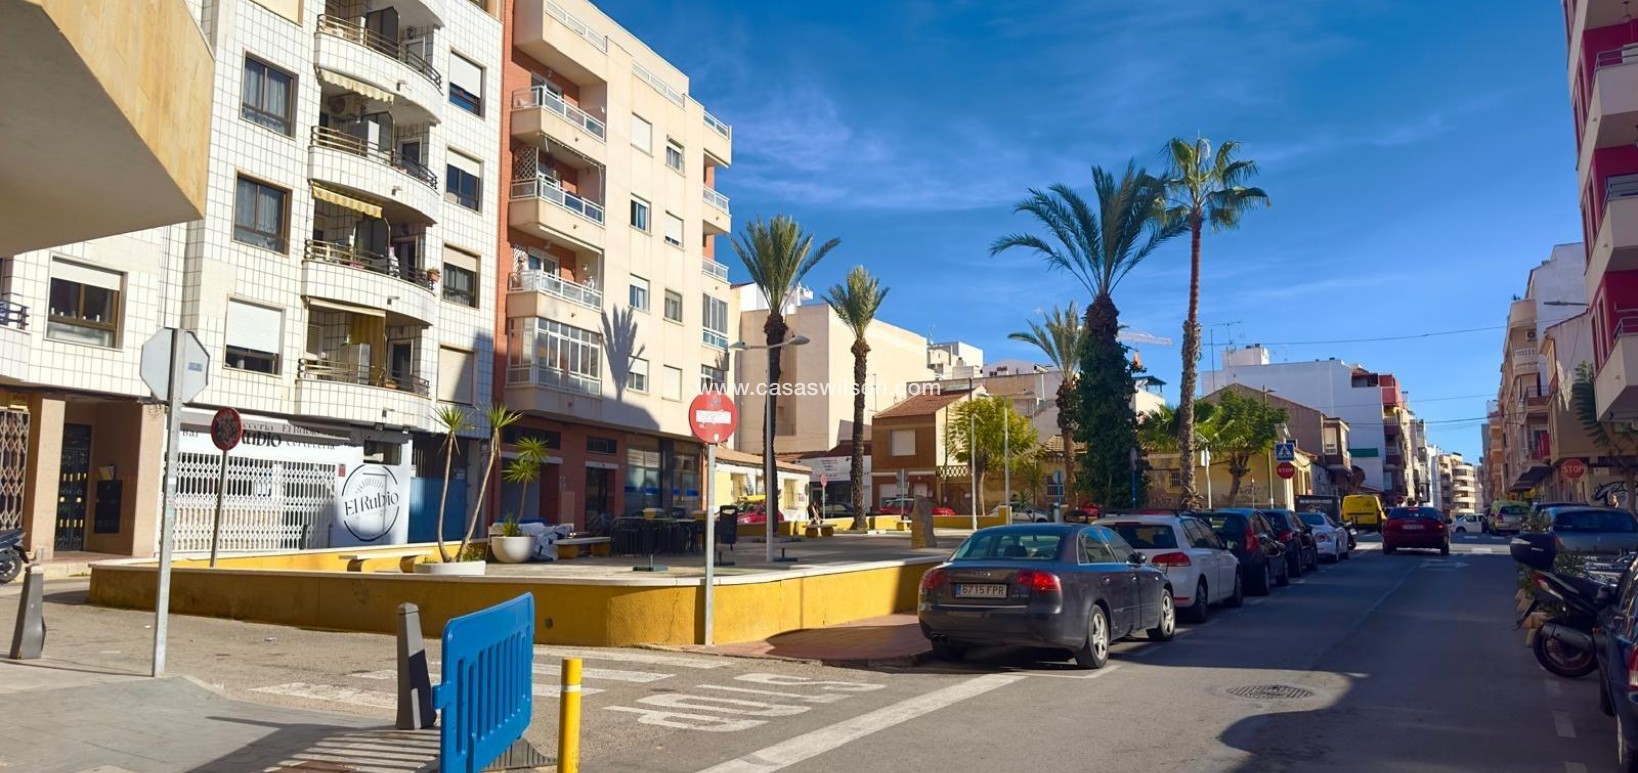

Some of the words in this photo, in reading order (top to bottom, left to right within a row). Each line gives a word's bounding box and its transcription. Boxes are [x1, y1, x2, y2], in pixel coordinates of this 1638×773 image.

[1563, 465, 1584, 473] STOP
[344, 498, 358, 516] El
[360, 491, 399, 512] Rubio
[986, 585, 1004, 596] FPR
